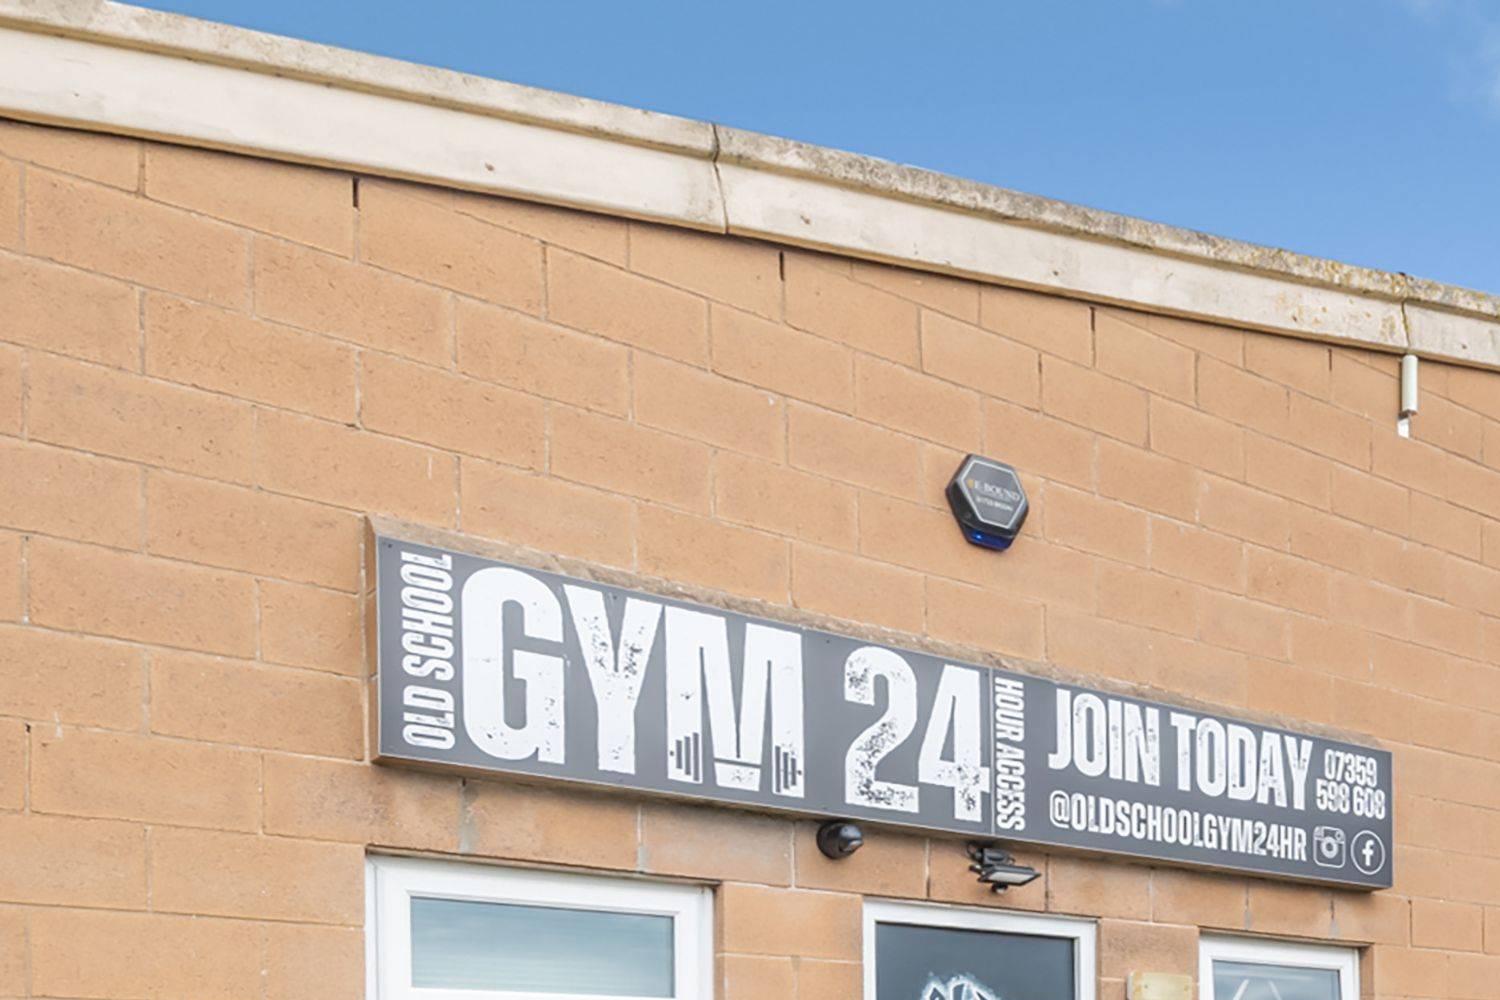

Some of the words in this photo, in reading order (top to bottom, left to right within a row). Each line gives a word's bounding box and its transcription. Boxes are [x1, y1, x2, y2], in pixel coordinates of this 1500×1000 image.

[400, 551, 455, 681] SCHOOL
[402, 685, 456, 750] OLD
[460, 566, 805, 798] GYM
[843, 645, 990, 823] 24
[994, 677, 1025, 742] HOUR
[1048, 688, 1160, 787] JOIN
[1169, 711, 1313, 811] TODAY
[1324, 749, 1377, 788] 07359
[995, 741, 1026, 831] ACCESS
[1316, 778, 1350, 814] 598
[1352, 785, 1386, 820] 608
[1049, 790, 1307, 862] @OLDSCHOOLGYM24HR
